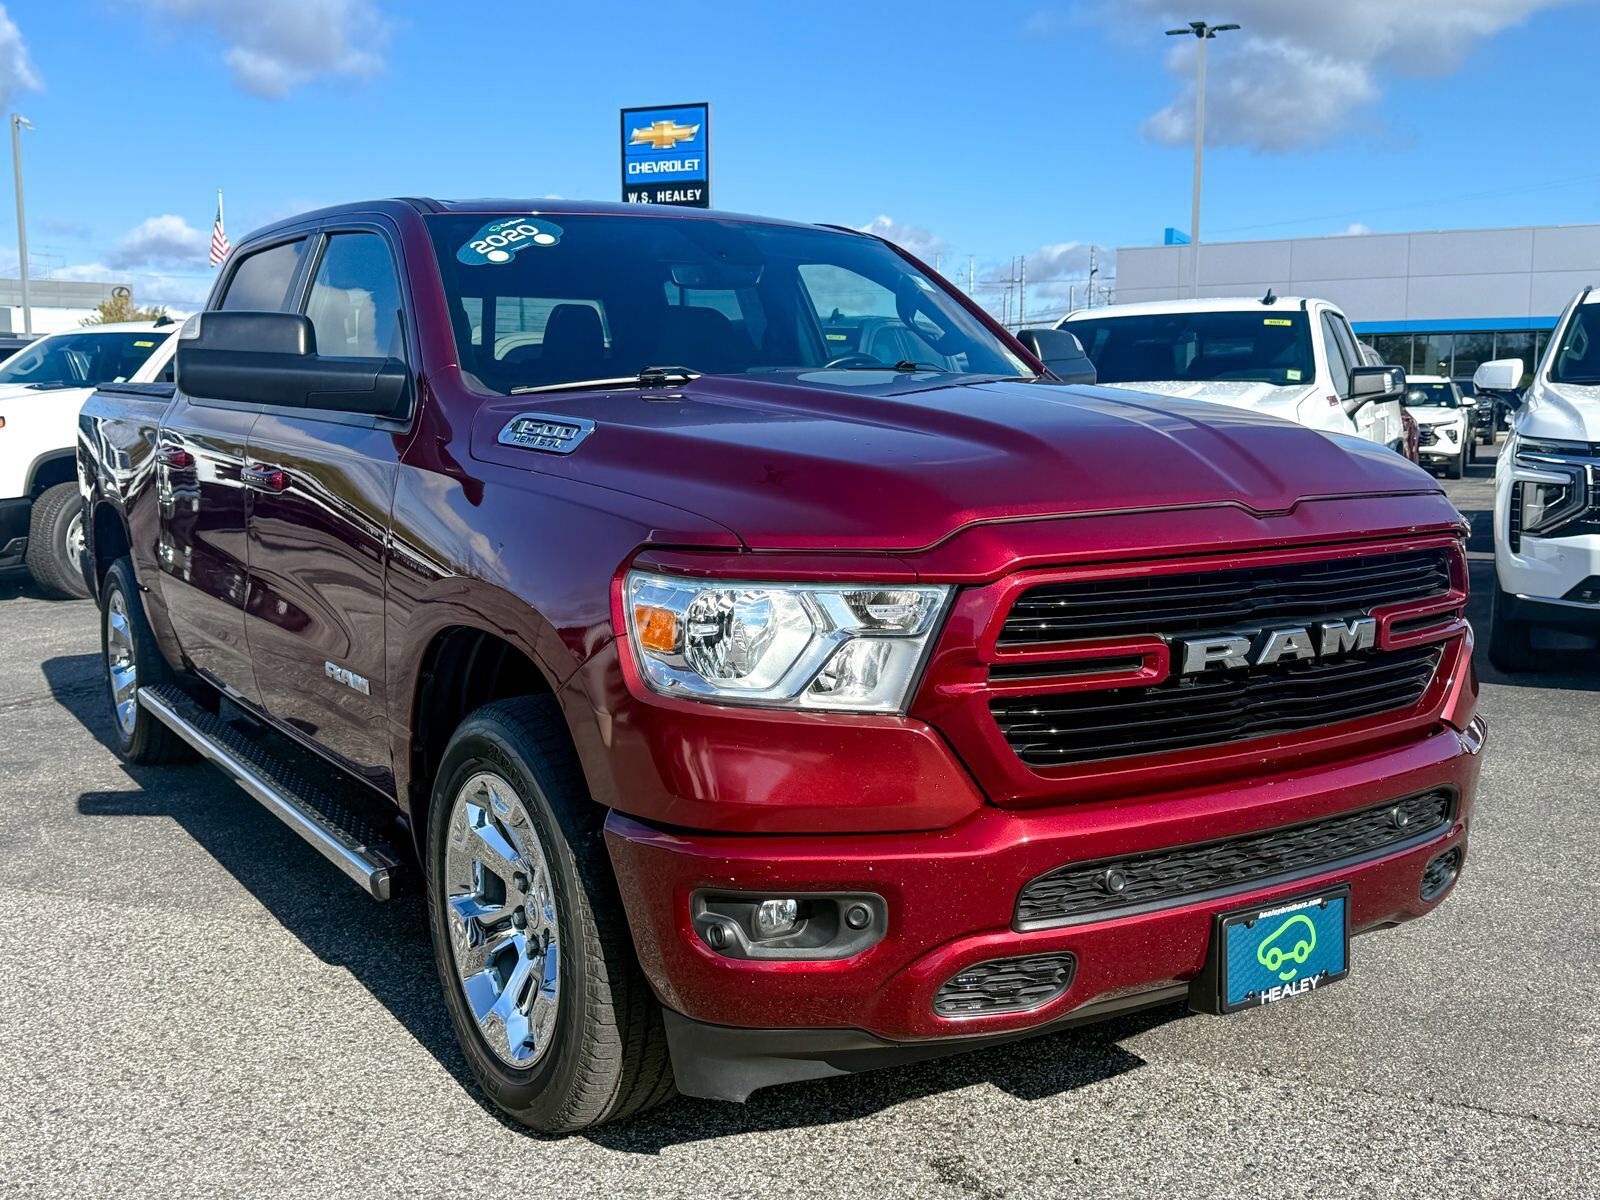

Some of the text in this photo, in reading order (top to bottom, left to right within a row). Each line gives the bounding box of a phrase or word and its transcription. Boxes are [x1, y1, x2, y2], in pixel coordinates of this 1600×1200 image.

[628, 159, 700, 175] CHEVROLET
[657, 189, 702, 203] HEALEY
[469, 224, 539, 254] 2020
[512, 434, 562, 449] HEMI 5.7L
[1182, 616, 1377, 675] RAM
[325, 661, 370, 696] RAM
[1261, 974, 1320, 1005] HEALEY
